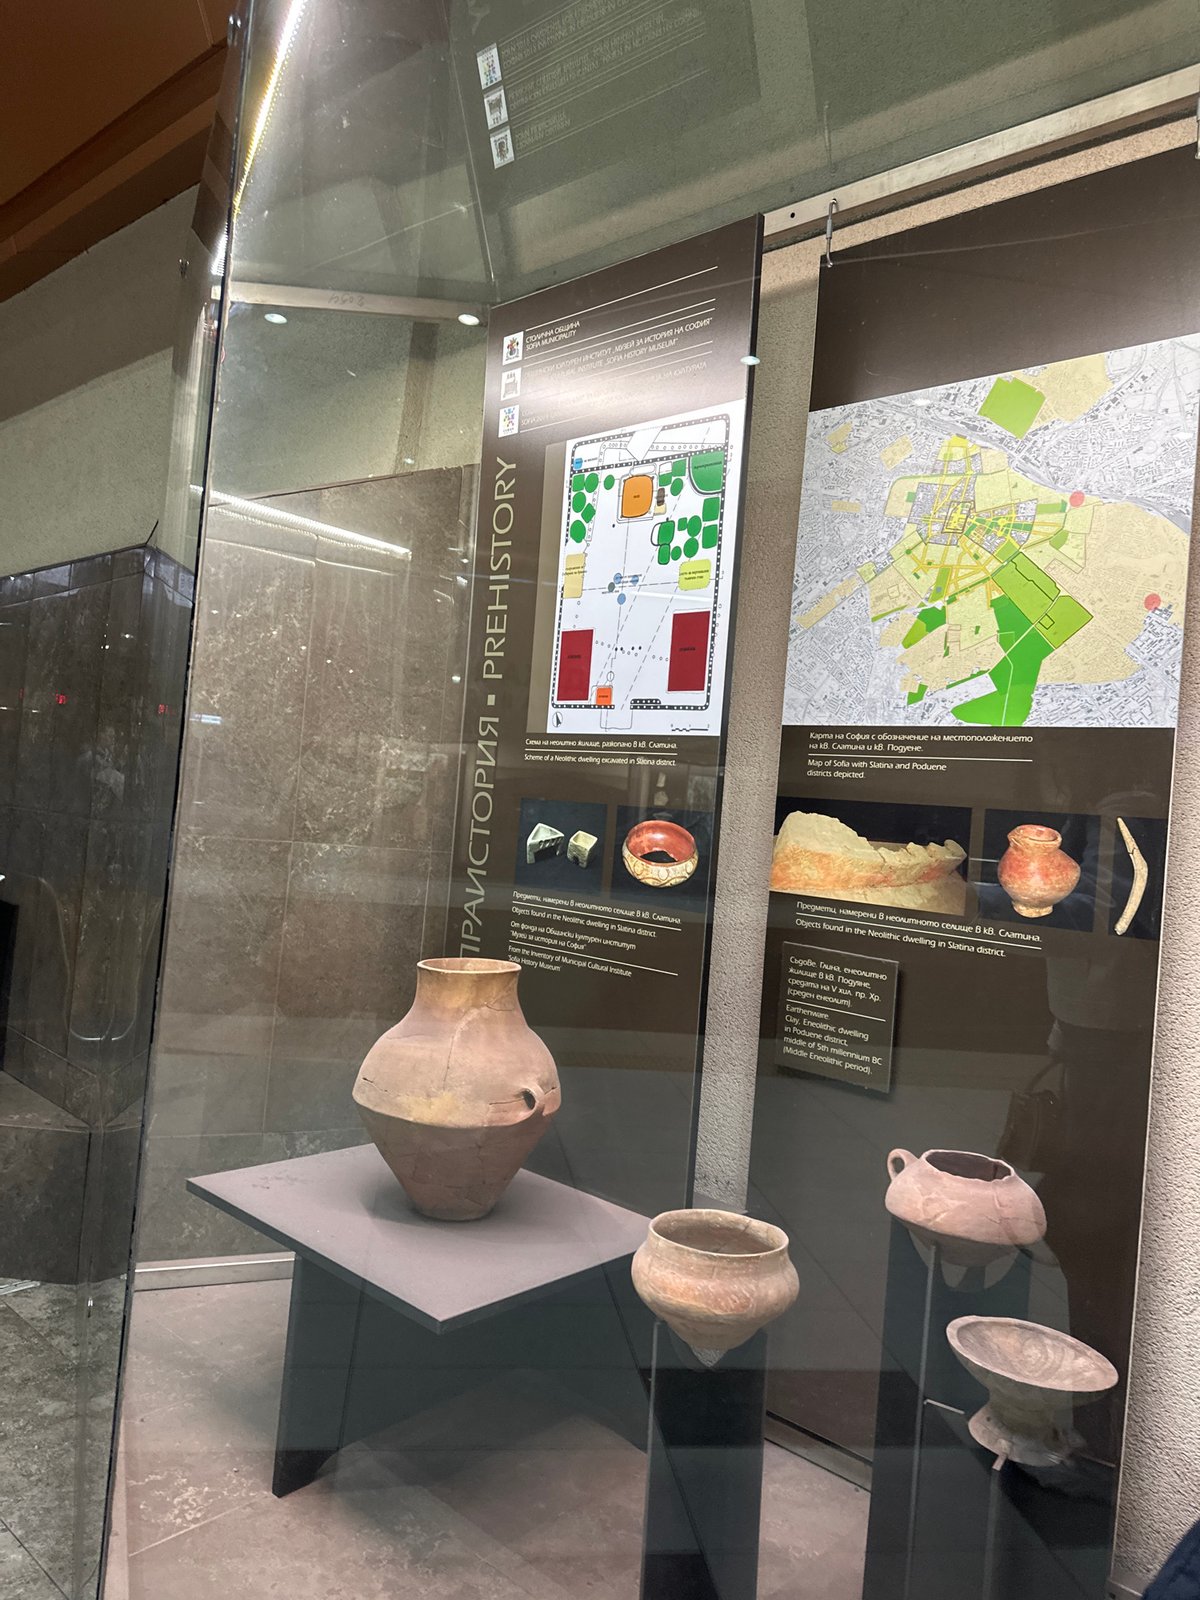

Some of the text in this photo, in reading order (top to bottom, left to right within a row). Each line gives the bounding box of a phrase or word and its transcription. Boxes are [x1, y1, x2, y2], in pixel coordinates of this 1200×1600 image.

[525, 321, 580, 343] СТОЛИЧНА ОБЩИНА
[526, 330, 577, 351] SOFIA MUNICIPALITY
[636, 338, 644, 347] ЗА
[644, 329, 673, 344] ИСТОРИЯ
[624, 346, 648, 359] HISTORY
[482, 456, 516, 679] PREHISTORY
[602, 741, 632, 749] разкопано
[649, 741, 677, 749] Слатина.
[810, 733, 833, 742] Карта
[846, 732, 870, 742] София
[877, 734, 929, 742] обозначение
[943, 735, 1033, 743] местоположението
[832, 743, 865, 751] Слатина
[874, 743, 885, 751] кв.
[887, 743, 924, 754] Подуене.
[578, 756, 600, 765] dwelling
[808, 759, 947, 771] Map of Sofia with Slatina and Poduene
[807, 770, 865, 779] districts depicted.
[513, 891, 681, 924] Предмети, намерени в неолитното селище в кв. Слатина.
[512, 906, 530, 917] Objects
[531, 909, 546, 919] found
[547, 911, 552, 919] in
[552, 912, 562, 921] the
[562, 913, 585, 925] Neolithic
[586, 918, 610, 931] dwelling
[610, 922, 616, 931] in
[617, 923, 636, 934] Slatina
[797, 901, 1042, 942] Предмети, намерени в неолитното селище в кв. Слатина.
[510, 921, 636, 951] От фонда на Общински културен институт
[527, 933, 534, 941] за
[535, 935, 558, 946] история
[796, 919, 1006, 957] Objects found in the Neolithic dwelling in Slatina district.
[508, 945, 632, 977] From the Inventory of Municipal Cultural Institute
[521, 957, 538, 969] History
[790, 956, 817, 968] Съдове.
[844, 968, 887, 980] енеолитно
[788, 967, 817, 979] жилище
[818, 971, 824, 979] в
[825, 974, 835, 982] кв.
[788, 978, 819, 990] средата
[831, 985, 837, 993] V
[838, 988, 852, 996] хил.
[855, 990, 867, 999] пр.
[869, 993, 881, 1002] Хр.
[788, 987, 815, 999] (среден
[793, 1027, 822, 1040] Poduene
[803, 1018, 836, 1033] Eneolithic
[838, 1026, 869, 1041] dwelling
[783, 1045, 872, 1075] (Middle Eneolithic period).
[784, 1036, 882, 1065] middle of 5th millennium BC
